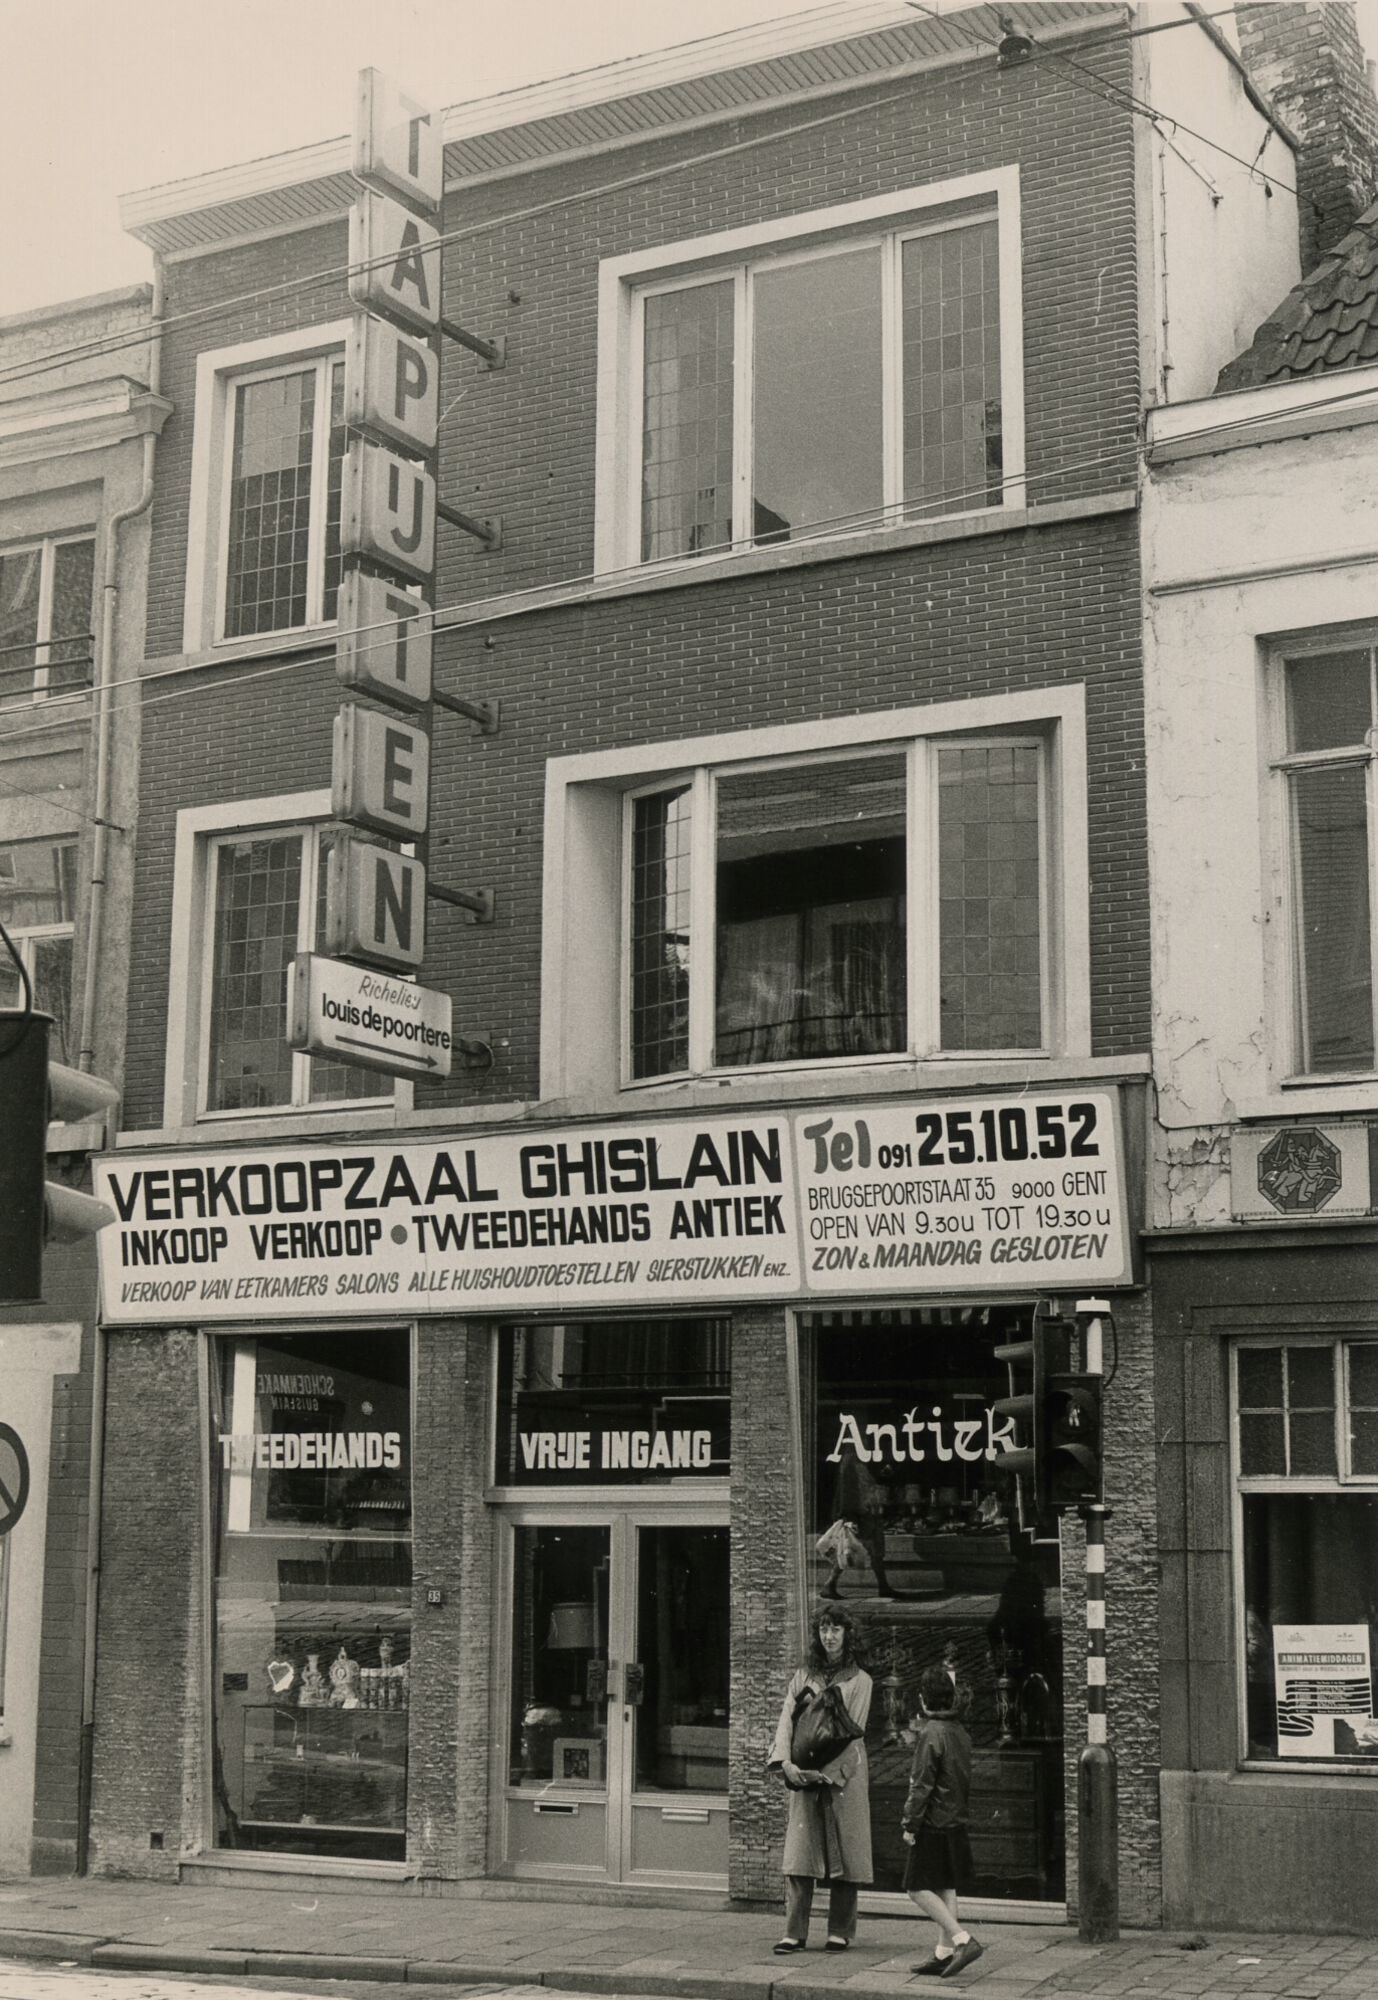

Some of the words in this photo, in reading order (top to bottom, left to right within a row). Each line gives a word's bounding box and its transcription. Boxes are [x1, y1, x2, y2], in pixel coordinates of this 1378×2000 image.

[803, 1117, 872, 1174] Tel
[878, 1144, 912, 1168] 091
[915, 1103, 1100, 1167] 25.10.52
[107, 1149, 499, 1222] VERKOOPZAAL
[519, 1127, 783, 1199] GHISLAIN
[808, 1178, 973, 1211] BRUGSEPOORTSTAAT
[975, 1177, 995, 1201] 35
[1012, 1181, 1055, 1199] 9000
[1062, 1170, 1108, 1197] GENT
[121, 1226, 228, 1266] INKOOP
[249, 1218, 382, 1260] VERKOOP
[412, 1203, 651, 1253] TWEEDEHANDS
[669, 1194, 786, 1240] ANTIEK
[810, 1215, 858, 1241] OPEN
[866, 1211, 906, 1237] VAN
[981, 1206, 1025, 1231] TOT
[812, 1245, 859, 1271] ZON
[859, 1252, 870, 1269] &
[872, 1239, 982, 1269] MAANDAG
[990, 1234, 1109, 1264] GESLOTEN
[121, 1279, 197, 1303] VERKOOP
[200, 1278, 232, 1300] VAN
[235, 1275, 329, 1299] EETKAMERS
[335, 1272, 400, 1296] SALONS
[408, 1269, 450, 1292] ALLE
[451, 1260, 640, 1291] HUISHOUDTOESTELLEN
[646, 1254, 764, 1282] SIERSTUKKEN
[218, 1432, 401, 1469] TWEEDEHANDS
[520, 1431, 590, 1469] VRIJE
[601, 1430, 711, 1469] INGANG
[826, 1406, 1029, 1463] Antiek
[429, 1591, 441, 1602] 35
